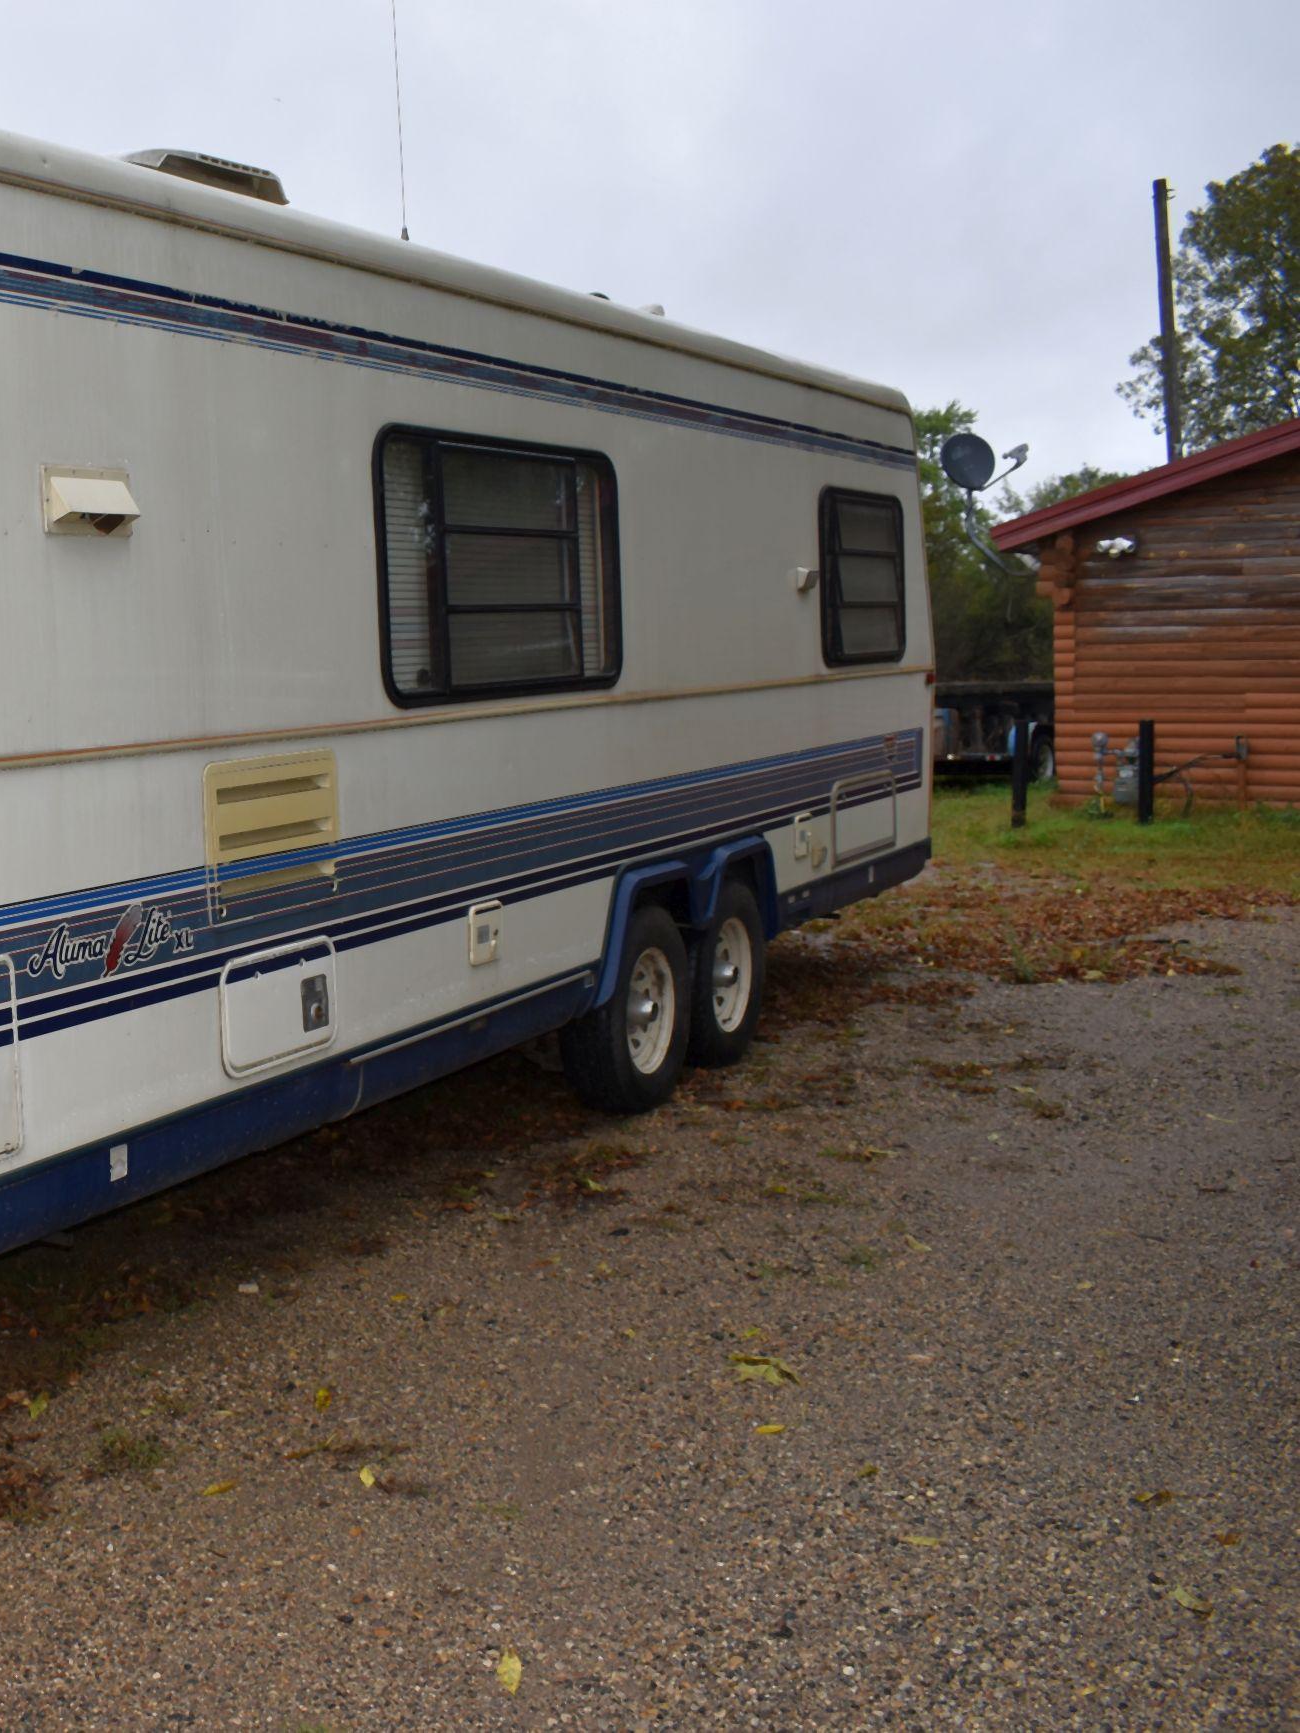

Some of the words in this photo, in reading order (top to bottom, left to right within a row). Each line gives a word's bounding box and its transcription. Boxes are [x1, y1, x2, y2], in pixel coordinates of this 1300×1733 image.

[29, 923, 105, 978] Aluma
[124, 906, 171, 964] Lite
[174, 929, 194, 950] XL
